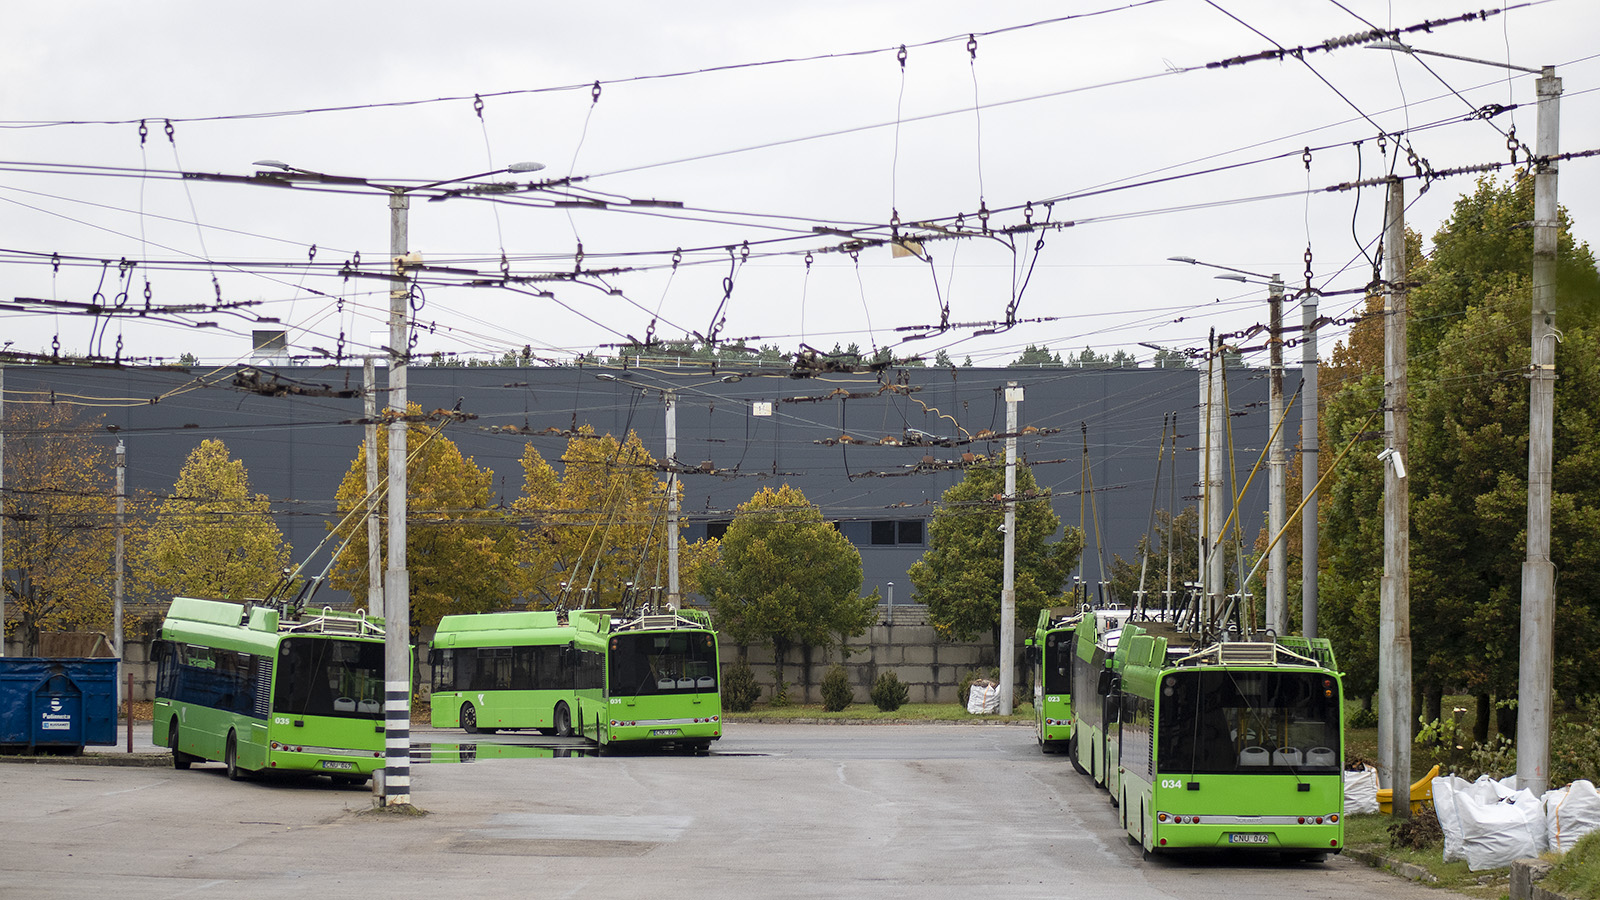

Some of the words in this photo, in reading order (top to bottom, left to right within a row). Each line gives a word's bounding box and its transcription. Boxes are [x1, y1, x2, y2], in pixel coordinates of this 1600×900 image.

[274, 717, 290, 725] 035
[1161, 779, 1182, 789] 034
[1233, 834, 1249, 842] CNU
[1253, 834, 1268, 843] 042
